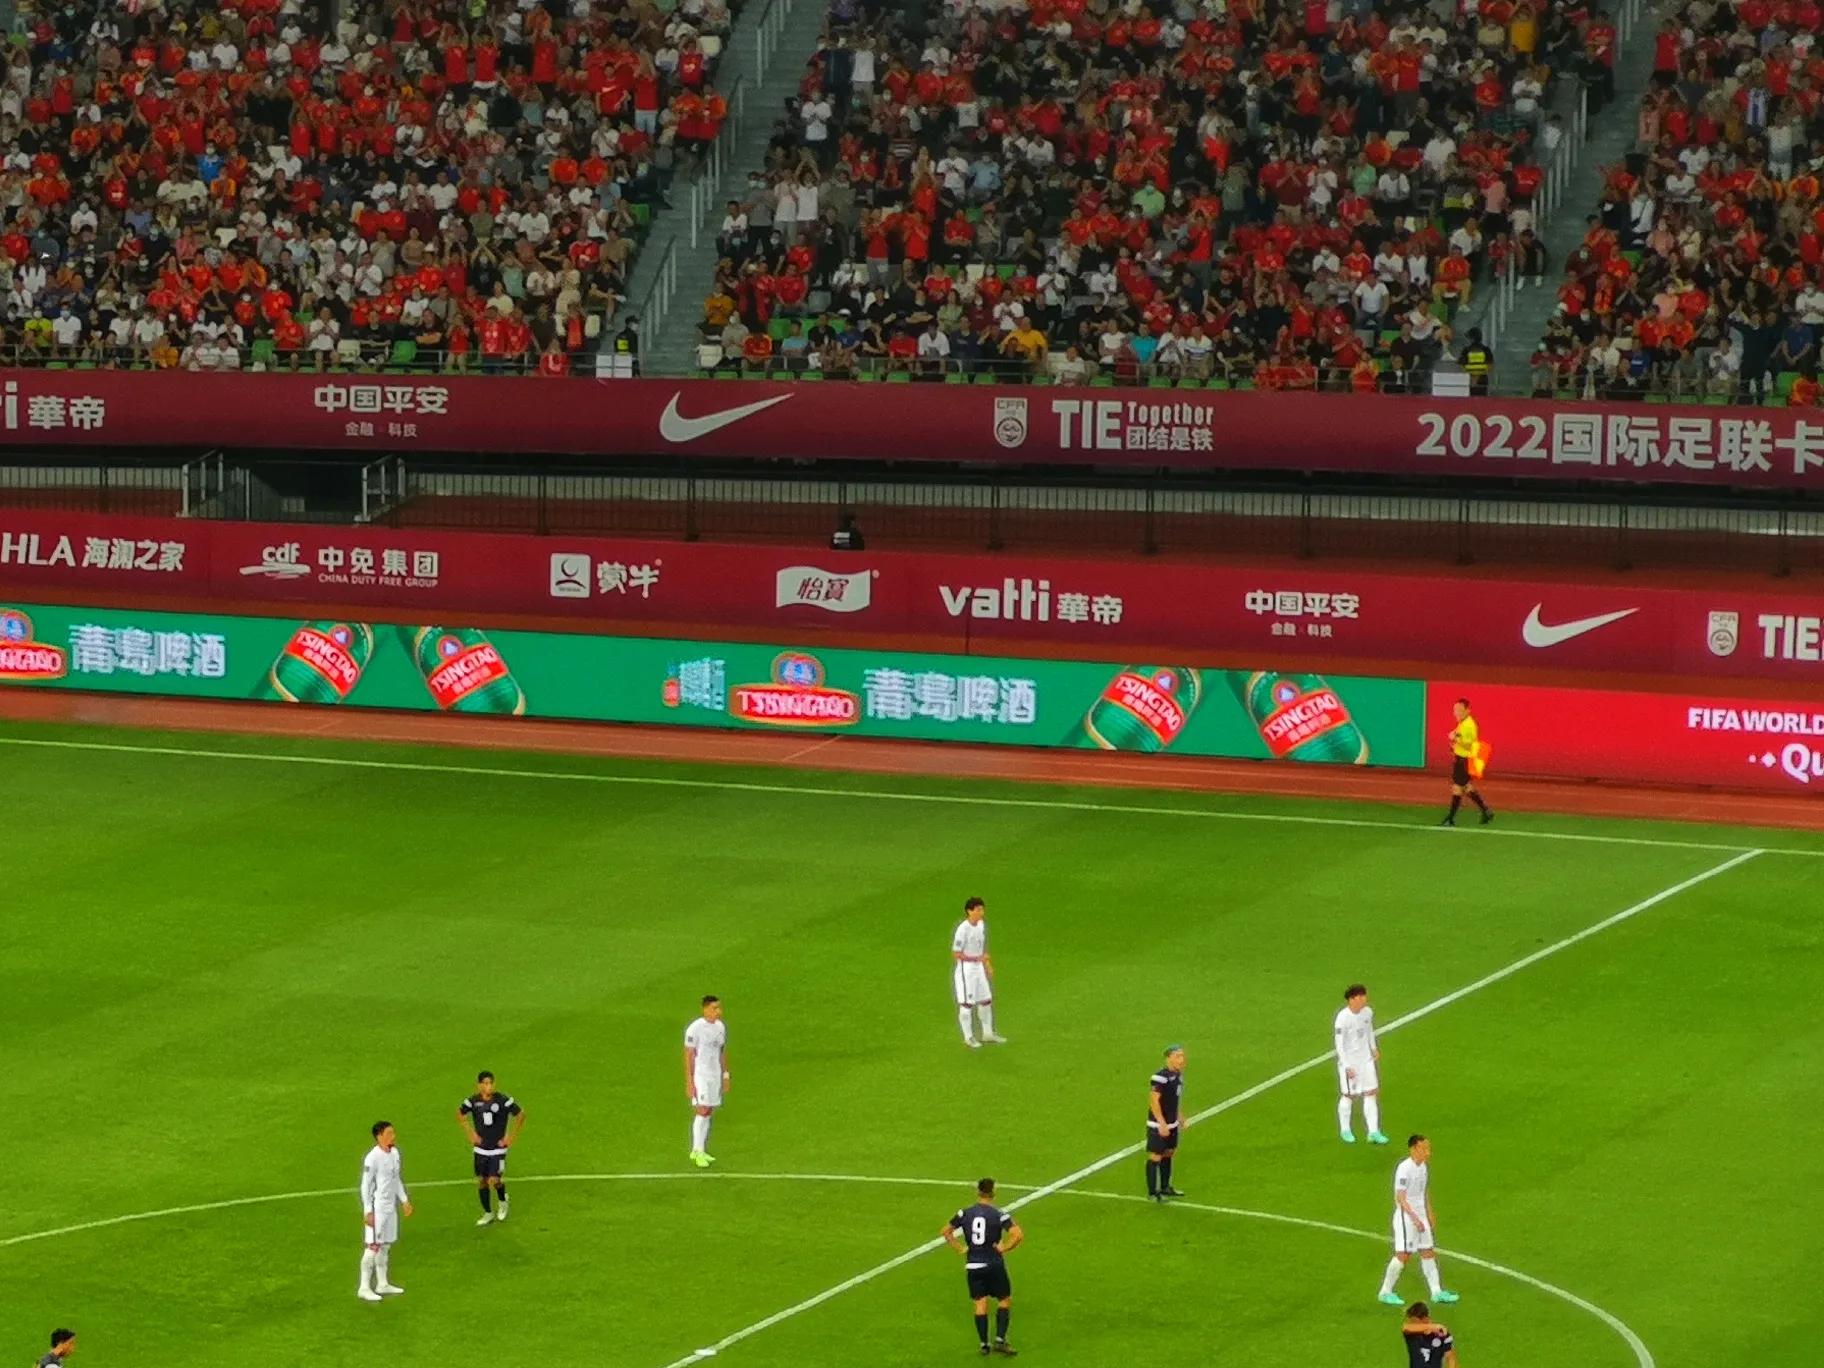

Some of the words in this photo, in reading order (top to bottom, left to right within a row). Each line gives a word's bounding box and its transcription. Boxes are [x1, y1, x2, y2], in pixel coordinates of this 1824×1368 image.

[28, 395, 105, 430] 華帝
[314, 384, 449, 414] 中国平安
[1127, 402, 1214, 425] Together
[1052, 400, 1123, 449] TIE
[1127, 426, 1214, 451] 团结是铁
[0, 531, 76, 567] HLA
[262, 543, 301, 564] cdf
[318, 546, 439, 578] 中免集团
[318, 573, 349, 584] CHINA
[351, 574, 376, 585] DUTY
[378, 575, 402, 586] FREE
[405, 576, 439, 587] GROUP
[597, 561, 660, 599] 蒙牛
[939, 578, 1050, 622] vatti
[1057, 592, 1123, 625] 華帝
[1245, 589, 1360, 618] 中国平安
[298, 631, 358, 684] TSINGTAO
[431, 646, 498, 694] TSINGTAO
[1116, 675, 1181, 732] TSINGTAO
[1263, 692, 1338, 741] TSINGTAO
[1687, 707, 1741, 731] FIFA
[971, 1216, 986, 1246] 9
